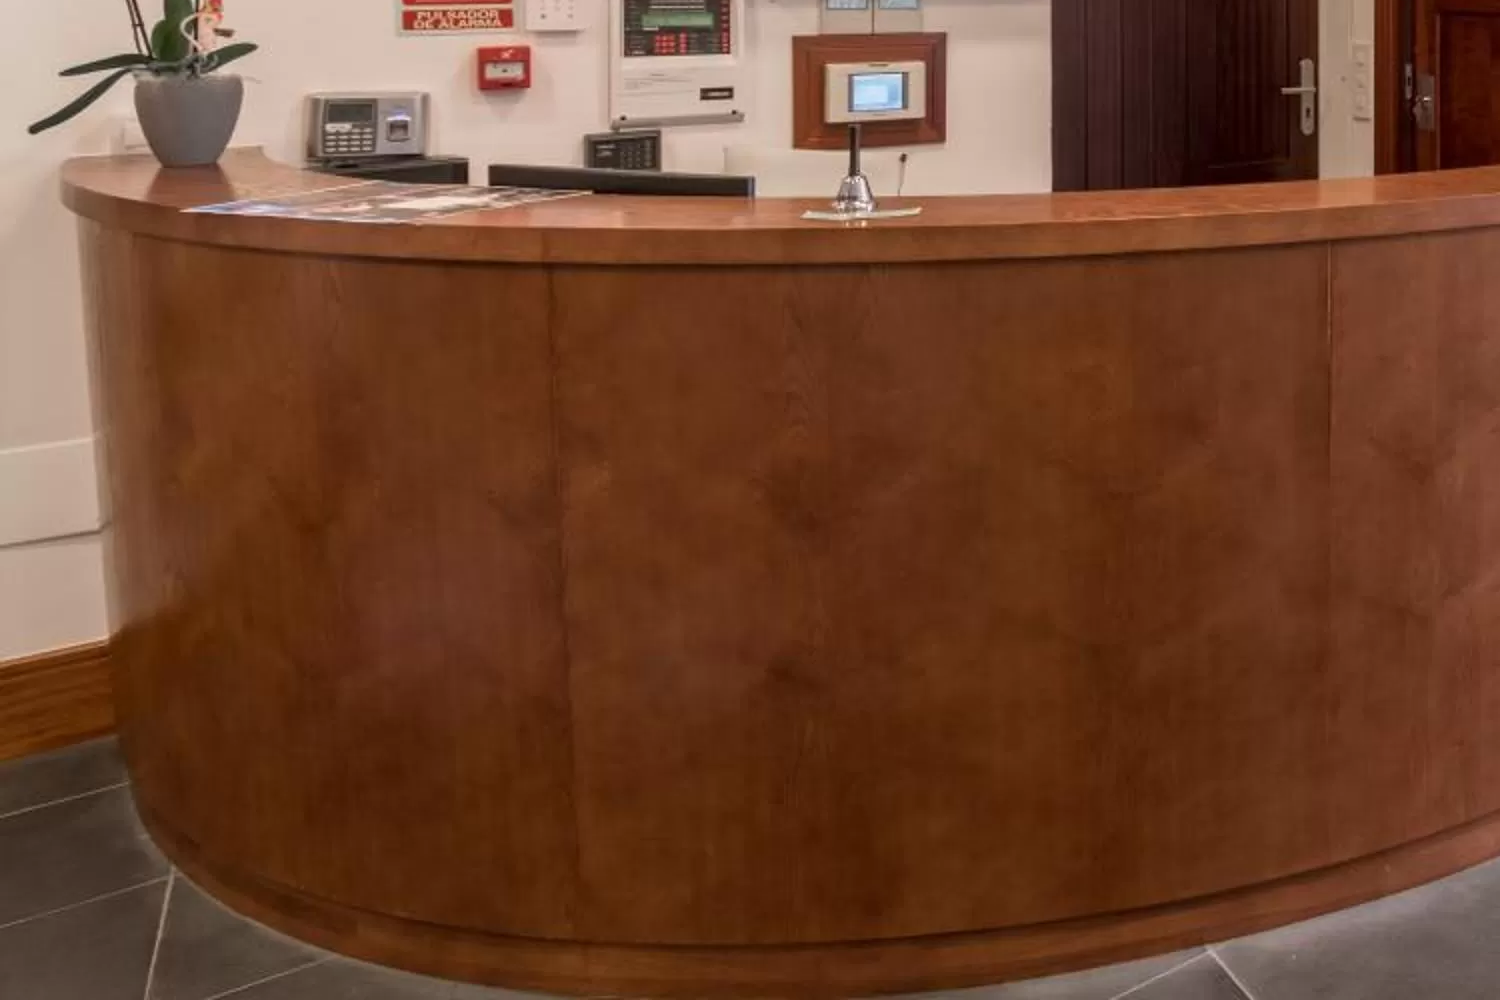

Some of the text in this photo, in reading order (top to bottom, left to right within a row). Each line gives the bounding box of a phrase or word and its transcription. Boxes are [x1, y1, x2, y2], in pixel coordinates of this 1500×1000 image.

[416, 9, 499, 20] PULSADOR
[413, 18, 502, 29] DE ALARMA
